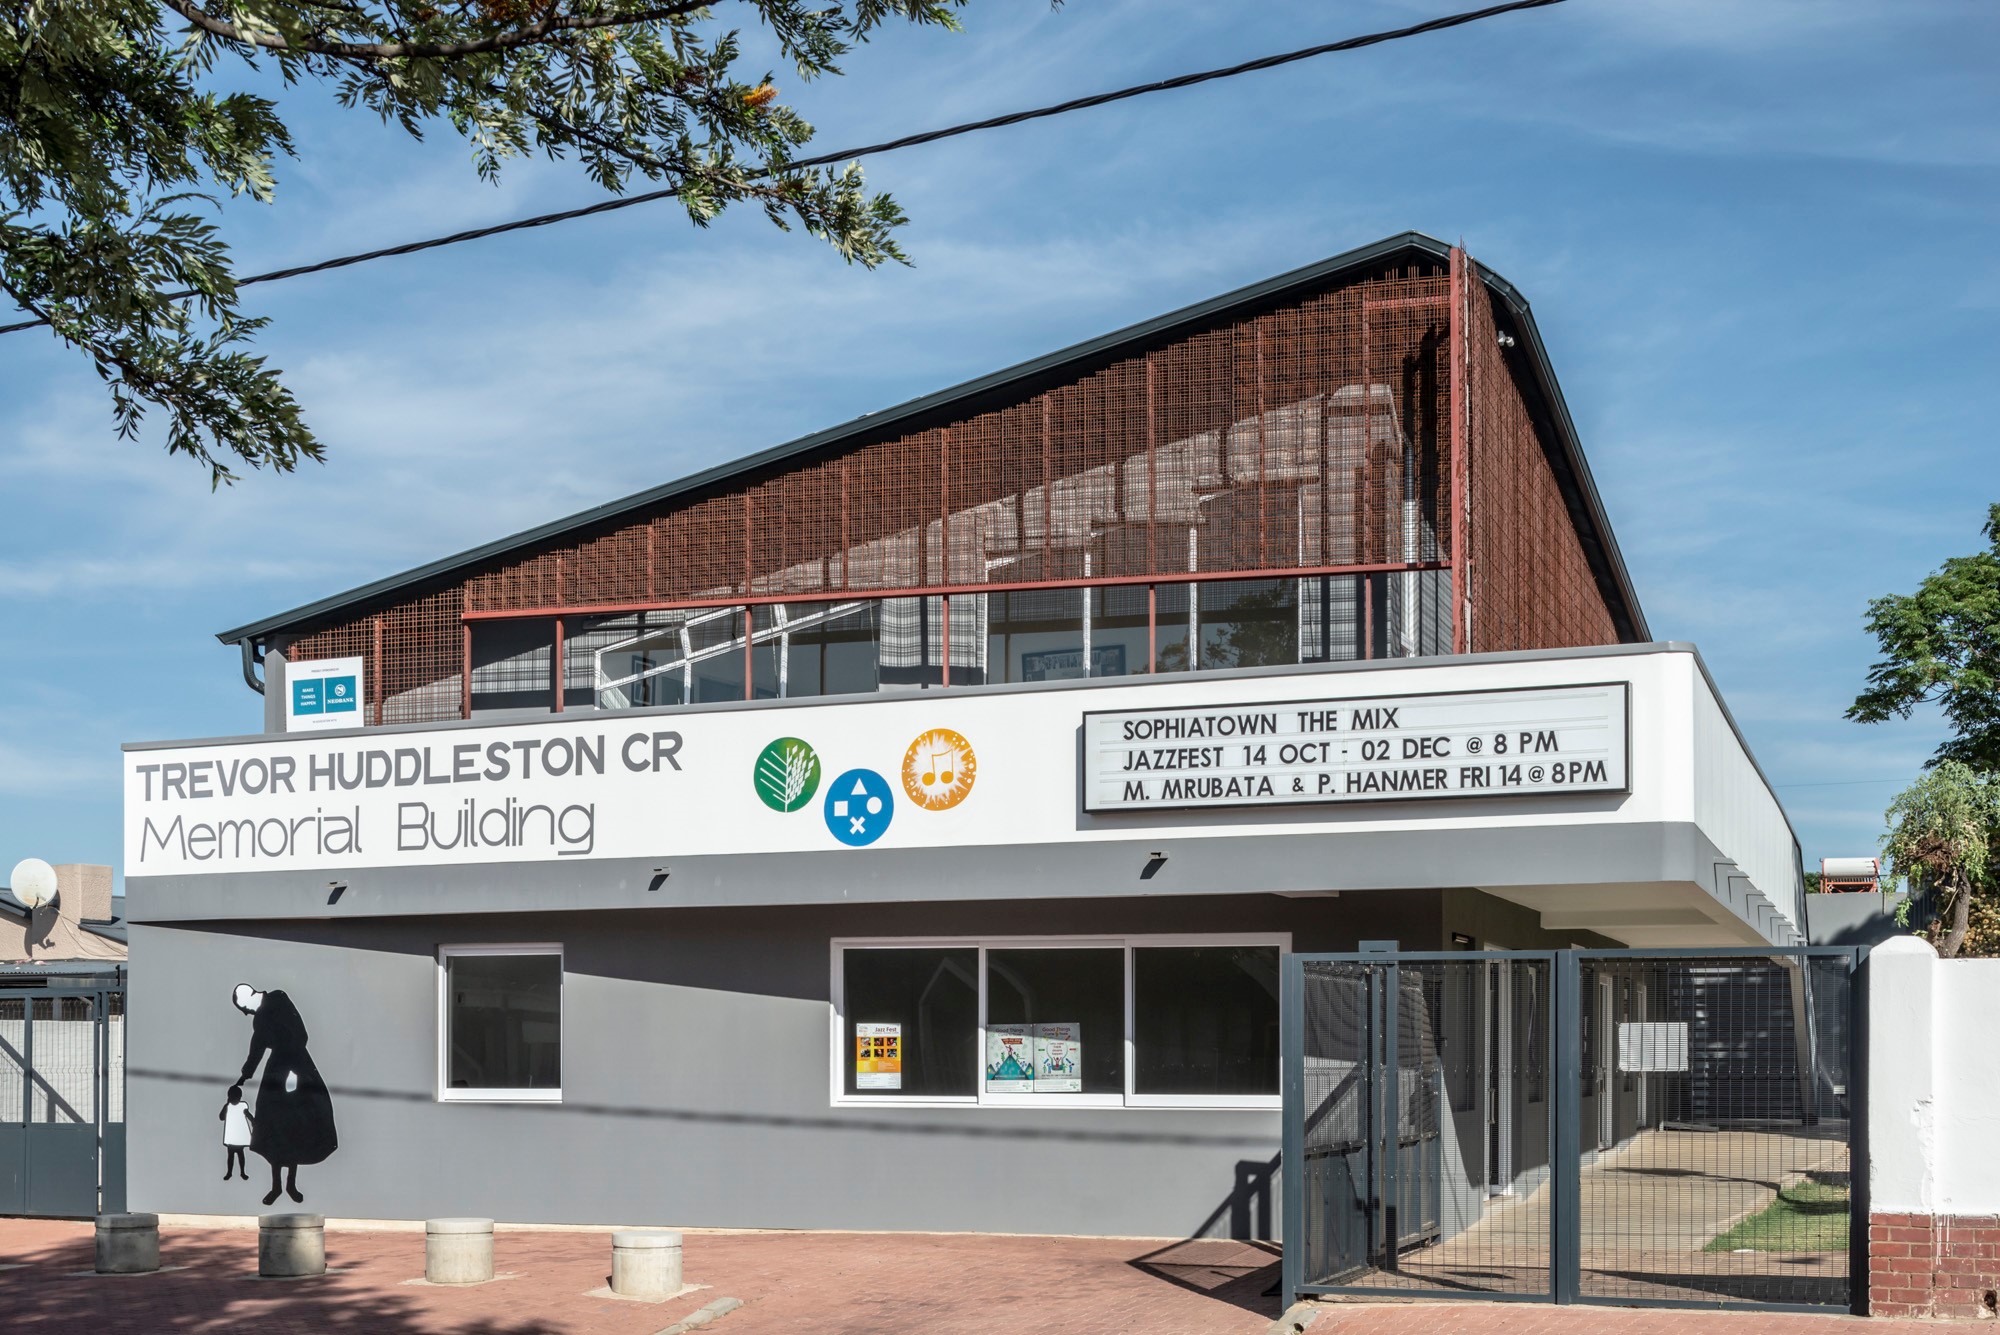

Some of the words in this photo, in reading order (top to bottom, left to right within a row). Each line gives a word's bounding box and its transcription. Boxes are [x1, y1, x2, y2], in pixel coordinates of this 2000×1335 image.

[1123, 713, 1277, 741] SOPHIATOWN
[1297, 710, 1337, 732] THE
[1351, 707, 1400, 730] MIX
[136, 756, 296, 802] TREVOR
[309, 735, 605, 792] HUDDLESTON
[621, 731, 683, 772] CR
[1123, 746, 1224, 771] JAZZFEST
[1242, 745, 1267, 766] 14
[1279, 742, 1331, 765] OCT
[1361, 739, 1390, 761] 02
[1402, 736, 1451, 759] DEC
[1466, 737, 1483, 754] @
[1493, 734, 1508, 755] 8
[1519, 730, 1559, 754] PM
[1123, 781, 1150, 801] M.
[1161, 775, 1275, 799] MRUBATA
[1292, 777, 1304, 792] &
[1318, 773, 1336, 794] P.
[1347, 768, 1448, 794] HANMER
[1460, 765, 1491, 789] FRI
[1499, 764, 1523, 786] 14
[1528, 765, 1545, 783] @
[140, 805, 362, 863] Memorial
[398, 797, 595, 856] Building
